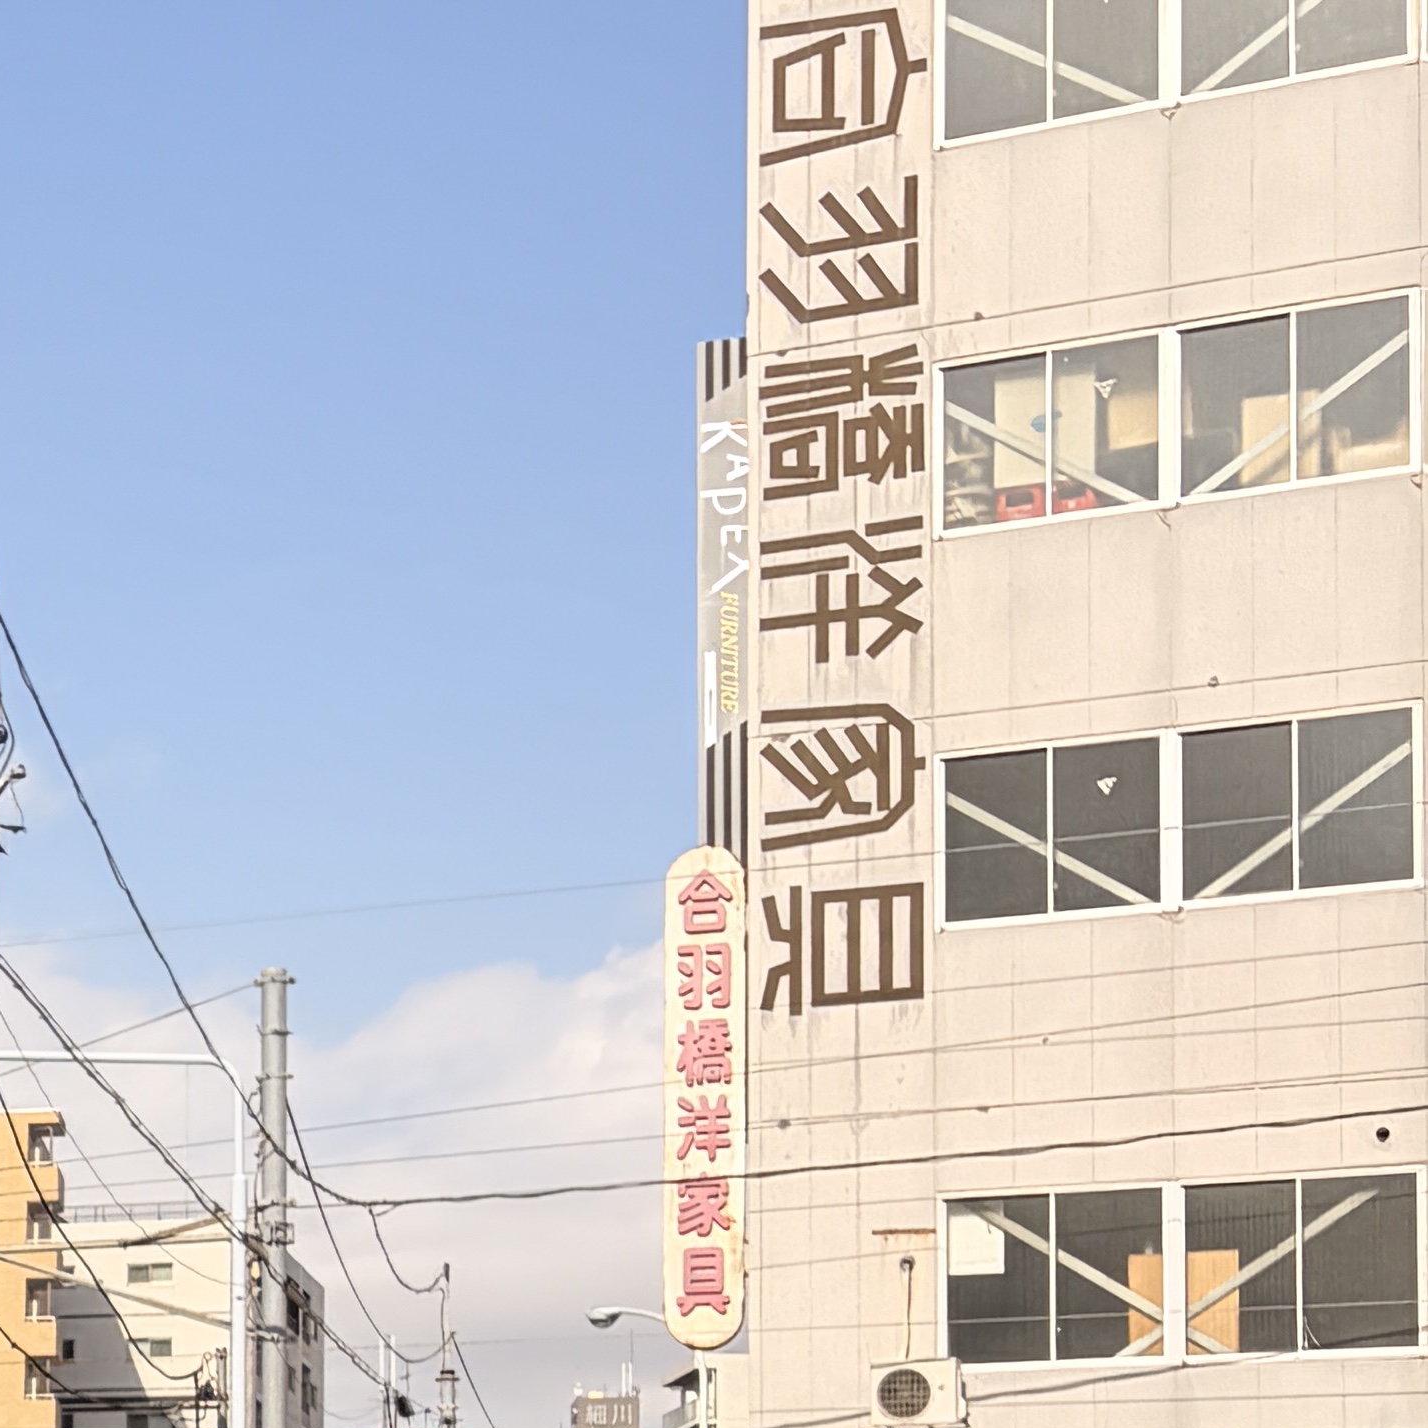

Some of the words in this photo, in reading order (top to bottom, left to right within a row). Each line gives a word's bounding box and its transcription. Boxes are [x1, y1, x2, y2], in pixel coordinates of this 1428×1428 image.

[719, 592, 740, 714] FURNITURE
[758, 8, 927, 1016] 合羽橋洋家具
[675, 868, 734, 1317] 合羽橋洋家具
